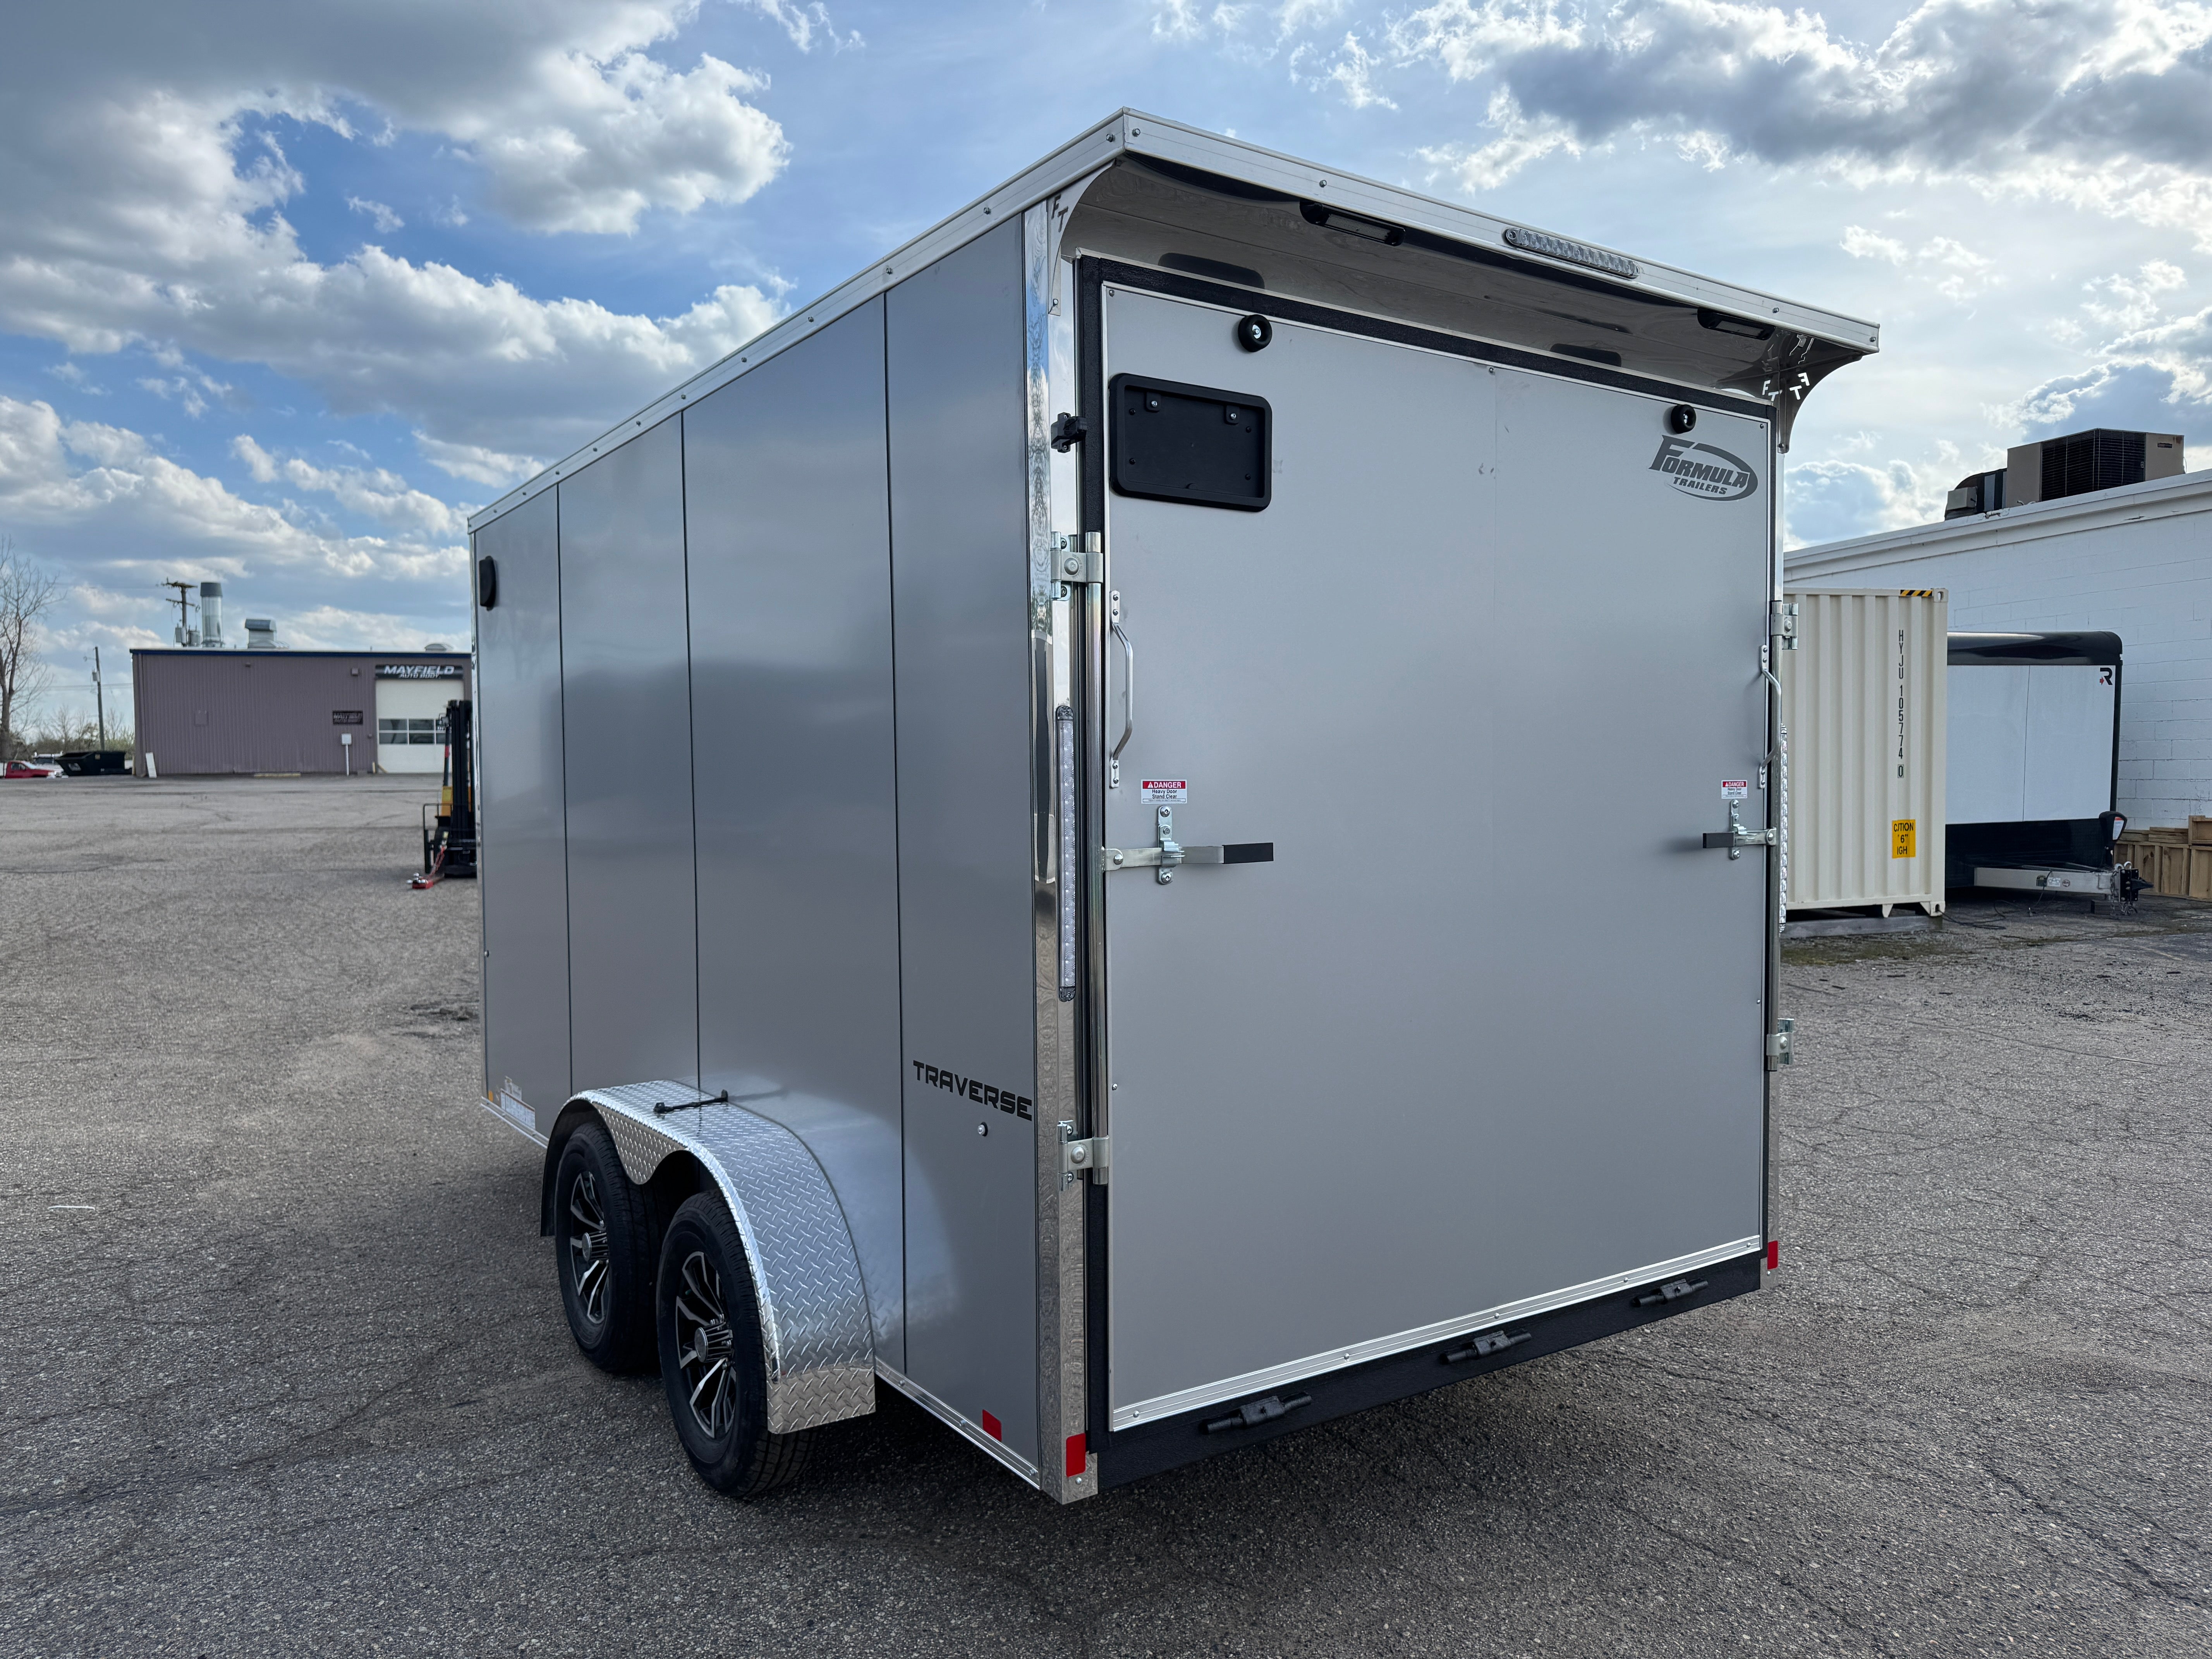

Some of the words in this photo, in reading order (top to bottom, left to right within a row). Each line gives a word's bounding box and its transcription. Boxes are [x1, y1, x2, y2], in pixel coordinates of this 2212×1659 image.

[1648, 435, 1750, 488] FORMULA
[1673, 477, 1728, 495] TRAILERS
[384, 665, 455, 675] MAYFIELD
[2100, 668, 2113, 685] R
[1894, 823, 1913, 832] CTION
[913, 1060, 1032, 1121] TRAVERSE
